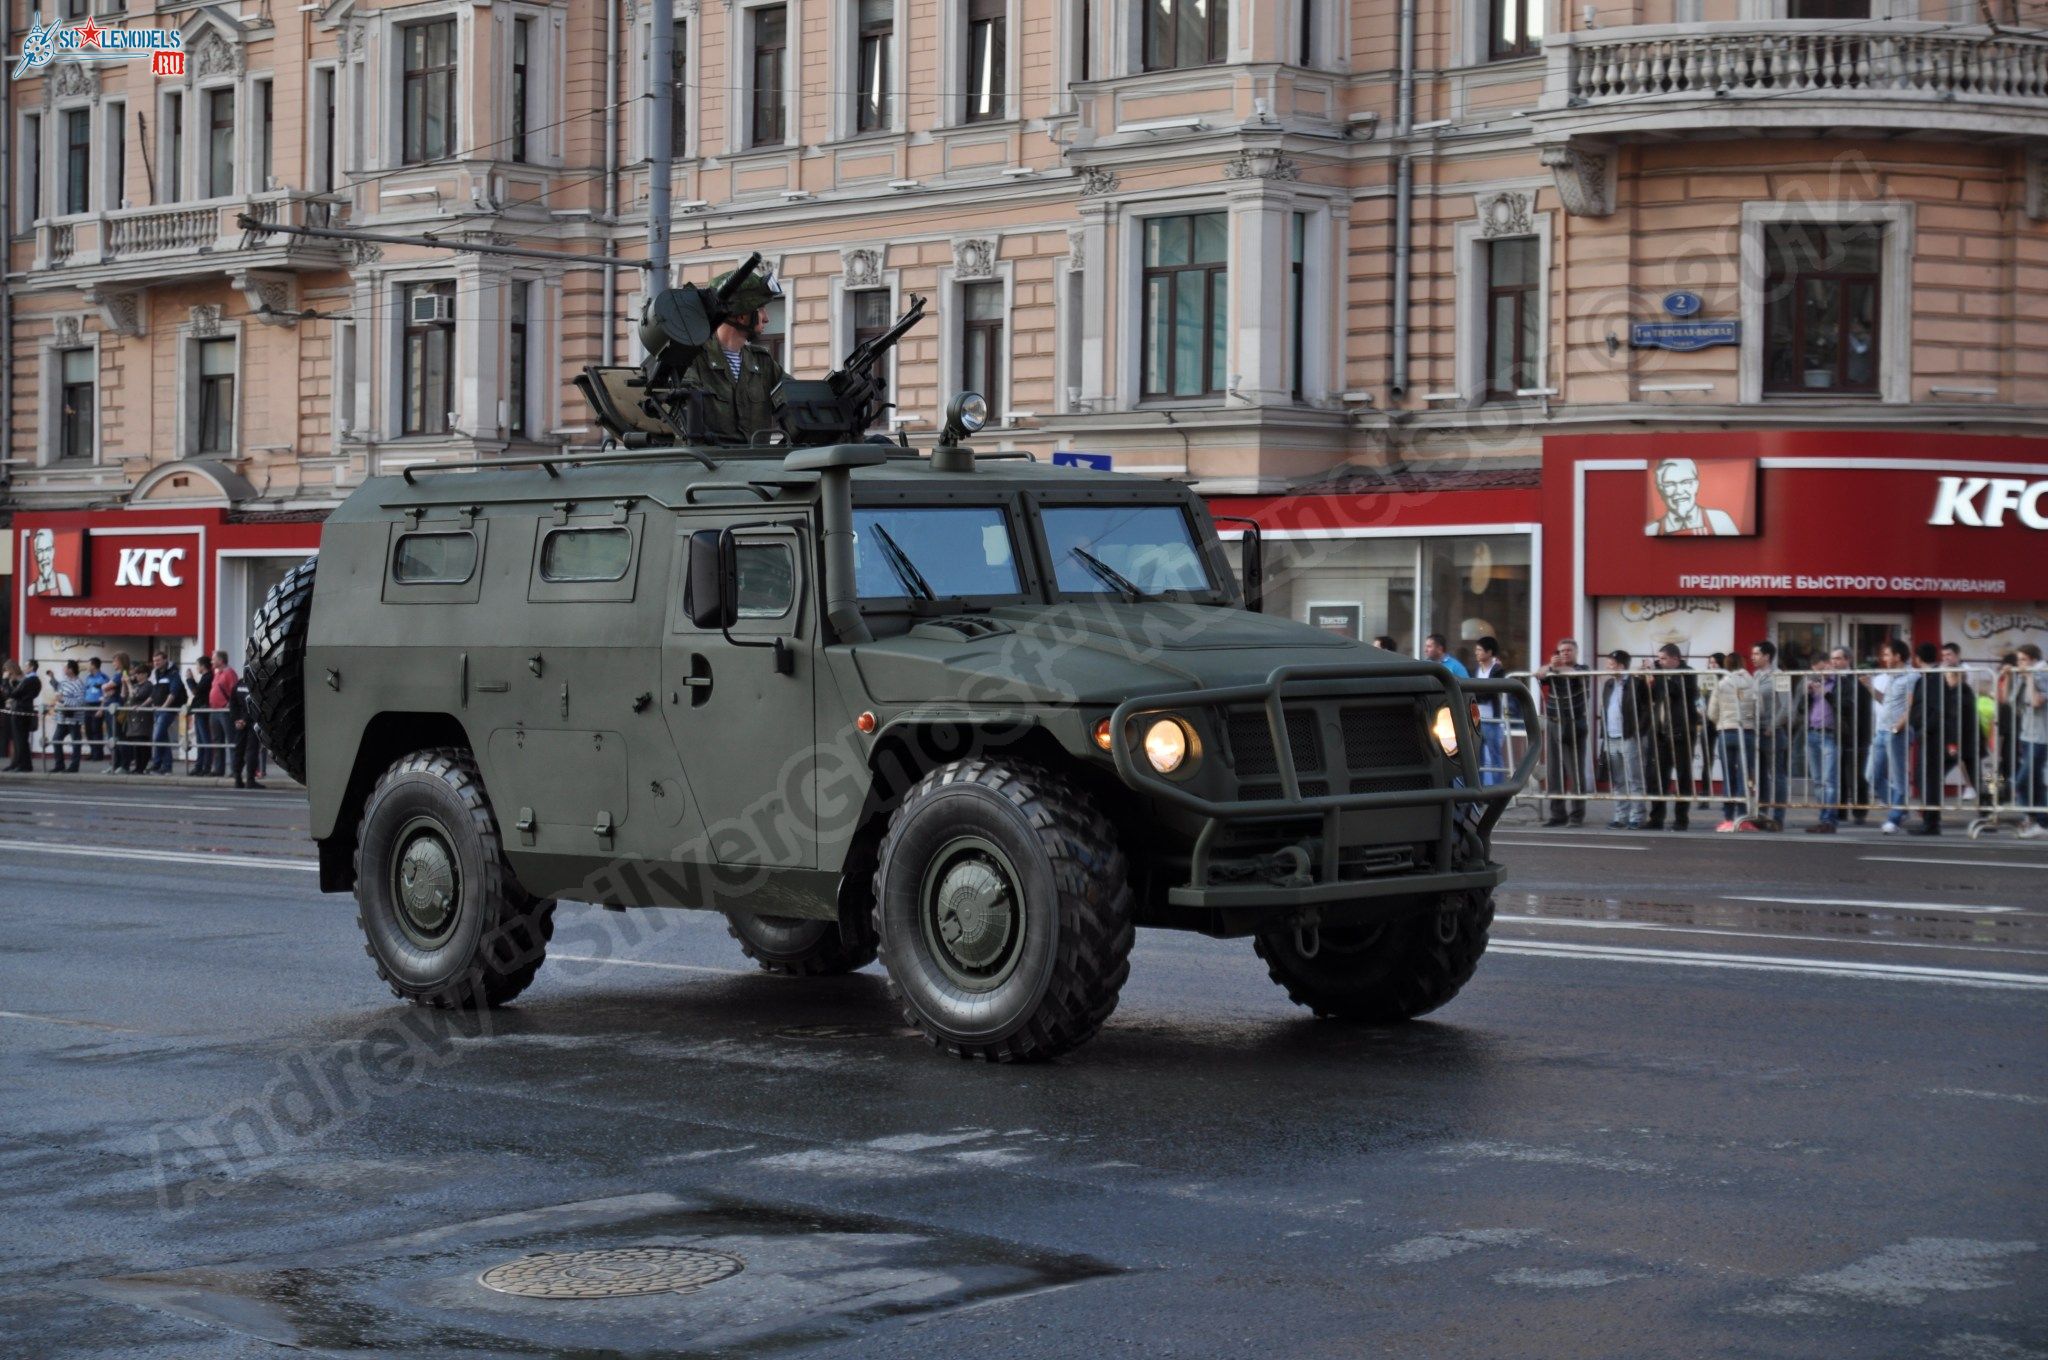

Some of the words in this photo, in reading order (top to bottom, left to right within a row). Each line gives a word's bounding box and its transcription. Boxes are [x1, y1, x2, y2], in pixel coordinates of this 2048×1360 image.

[1676, 295, 1687, 309] 2
[1926, 476, 2048, 530] KFC
[114, 548, 186, 587] KFC
[1679, 575, 1792, 590] ПРЕДПРИЯТИЕ
[1796, 576, 1887, 590] БЫСТРОГО
[1891, 577, 2006, 593] ОБСЛУЖИВАНИЯ
